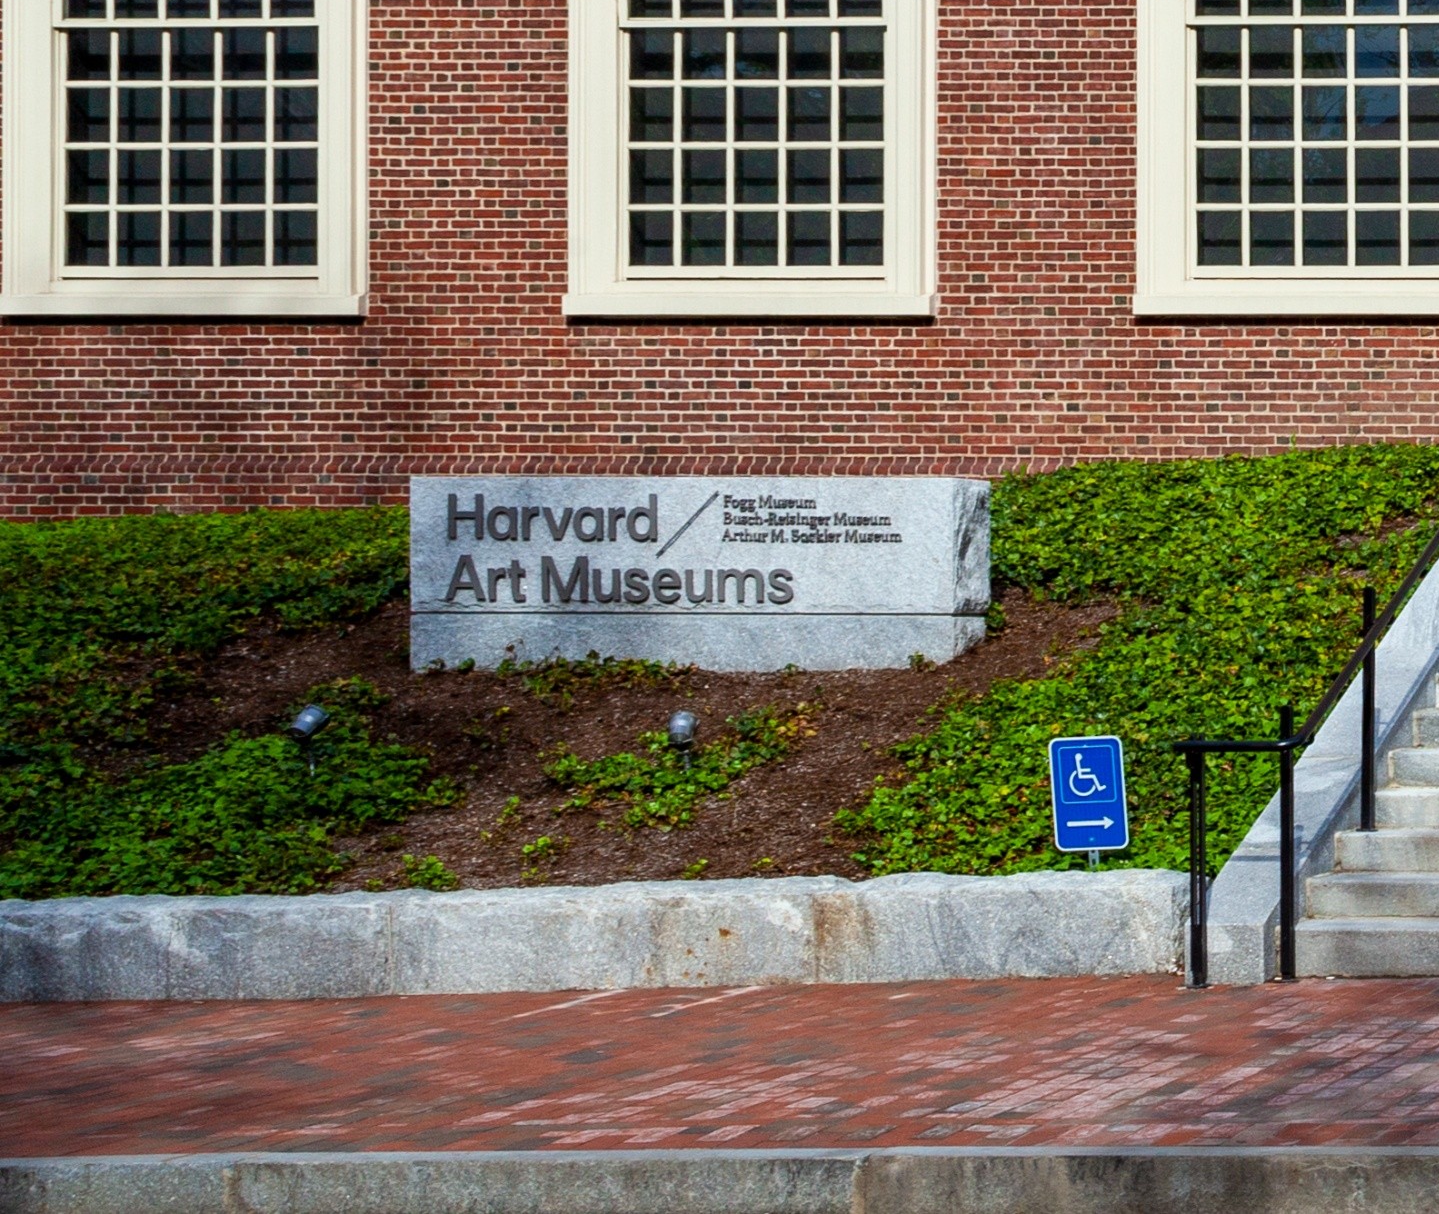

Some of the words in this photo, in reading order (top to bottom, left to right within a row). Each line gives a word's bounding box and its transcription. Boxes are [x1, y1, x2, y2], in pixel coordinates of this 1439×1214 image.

[723, 494, 756, 512] Fogg
[758, 494, 817, 510] Museum
[448, 493, 659, 543] Harvard
[723, 512, 831, 530] Busch-Reisinger
[833, 512, 892, 526] Museum
[721, 529, 769, 544] Arthur
[771, 529, 789, 544] M.
[791, 529, 842, 544] Sackler
[844, 529, 903, 544] Museum
[445, 554, 528, 603] Art
[541, 555, 795, 605] Museums
